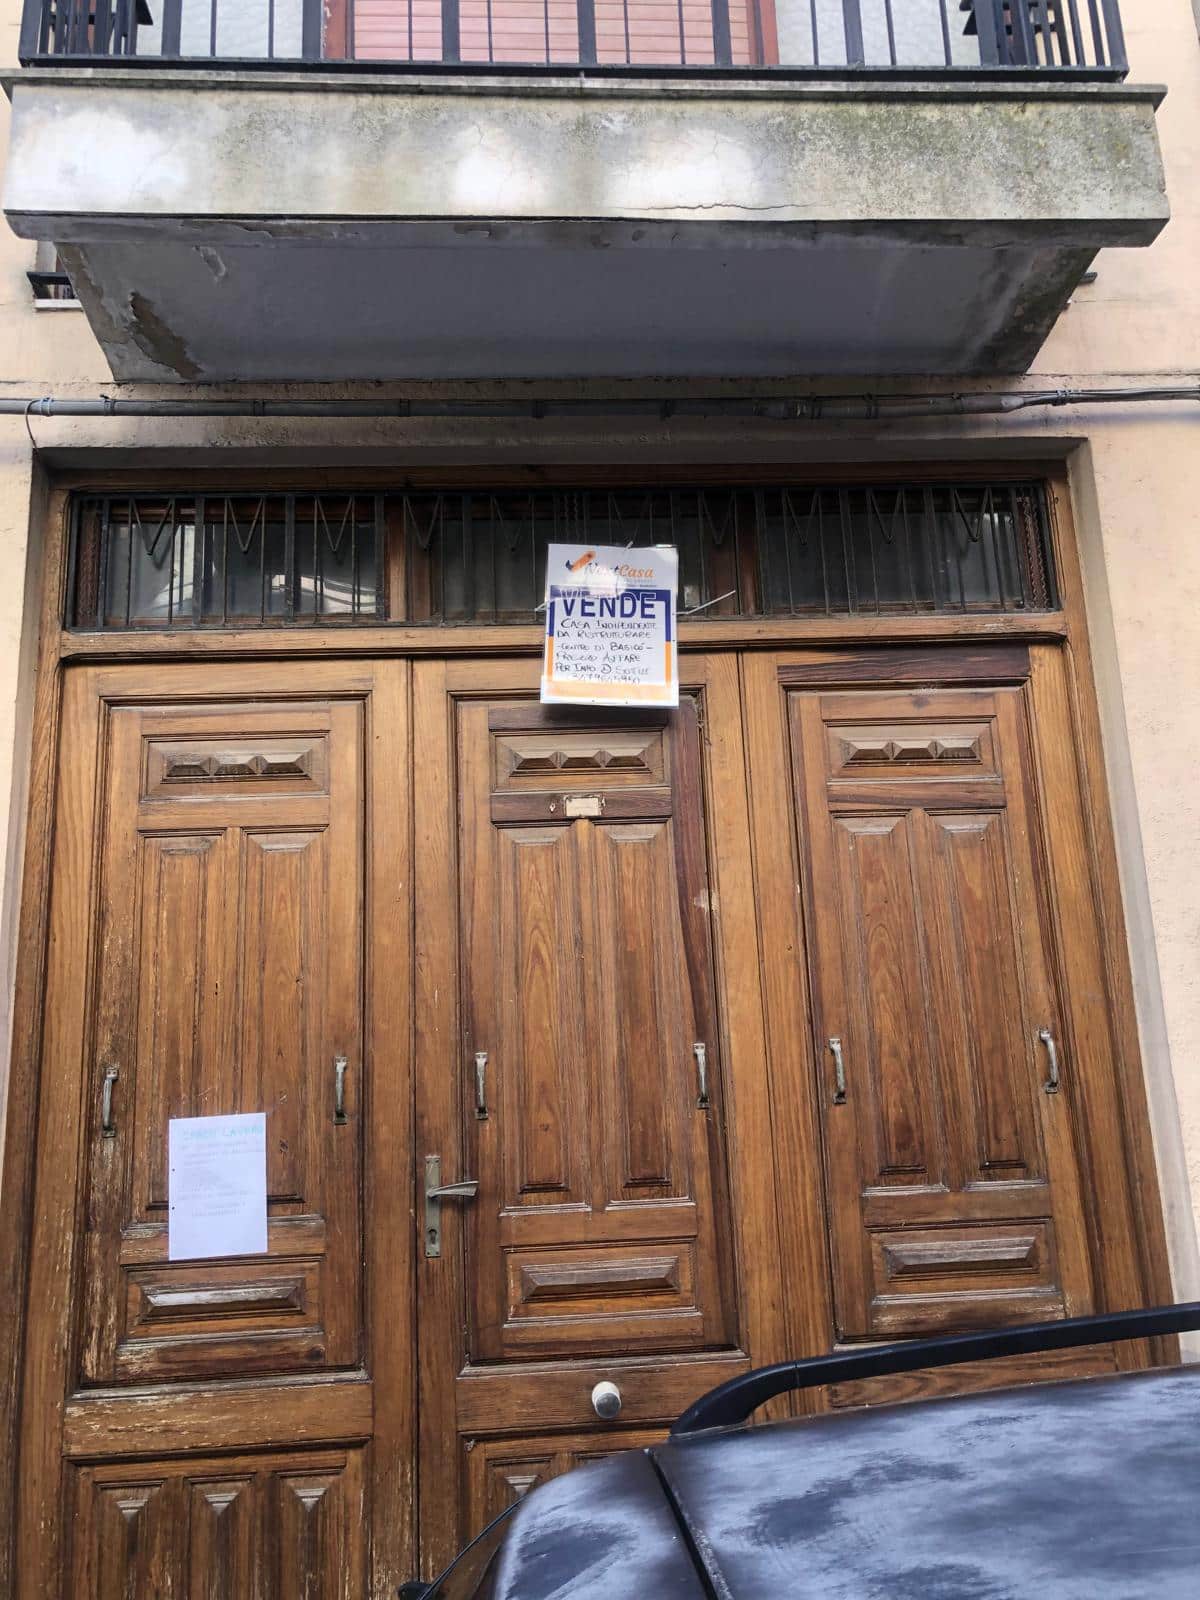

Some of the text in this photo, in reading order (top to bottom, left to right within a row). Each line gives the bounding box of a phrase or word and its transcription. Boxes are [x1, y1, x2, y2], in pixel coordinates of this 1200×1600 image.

[585, 562, 654, 578] NetCasa
[562, 591, 657, 619] VENDE
[560, 618, 590, 630] CASA
[557, 630, 570, 638] DA
